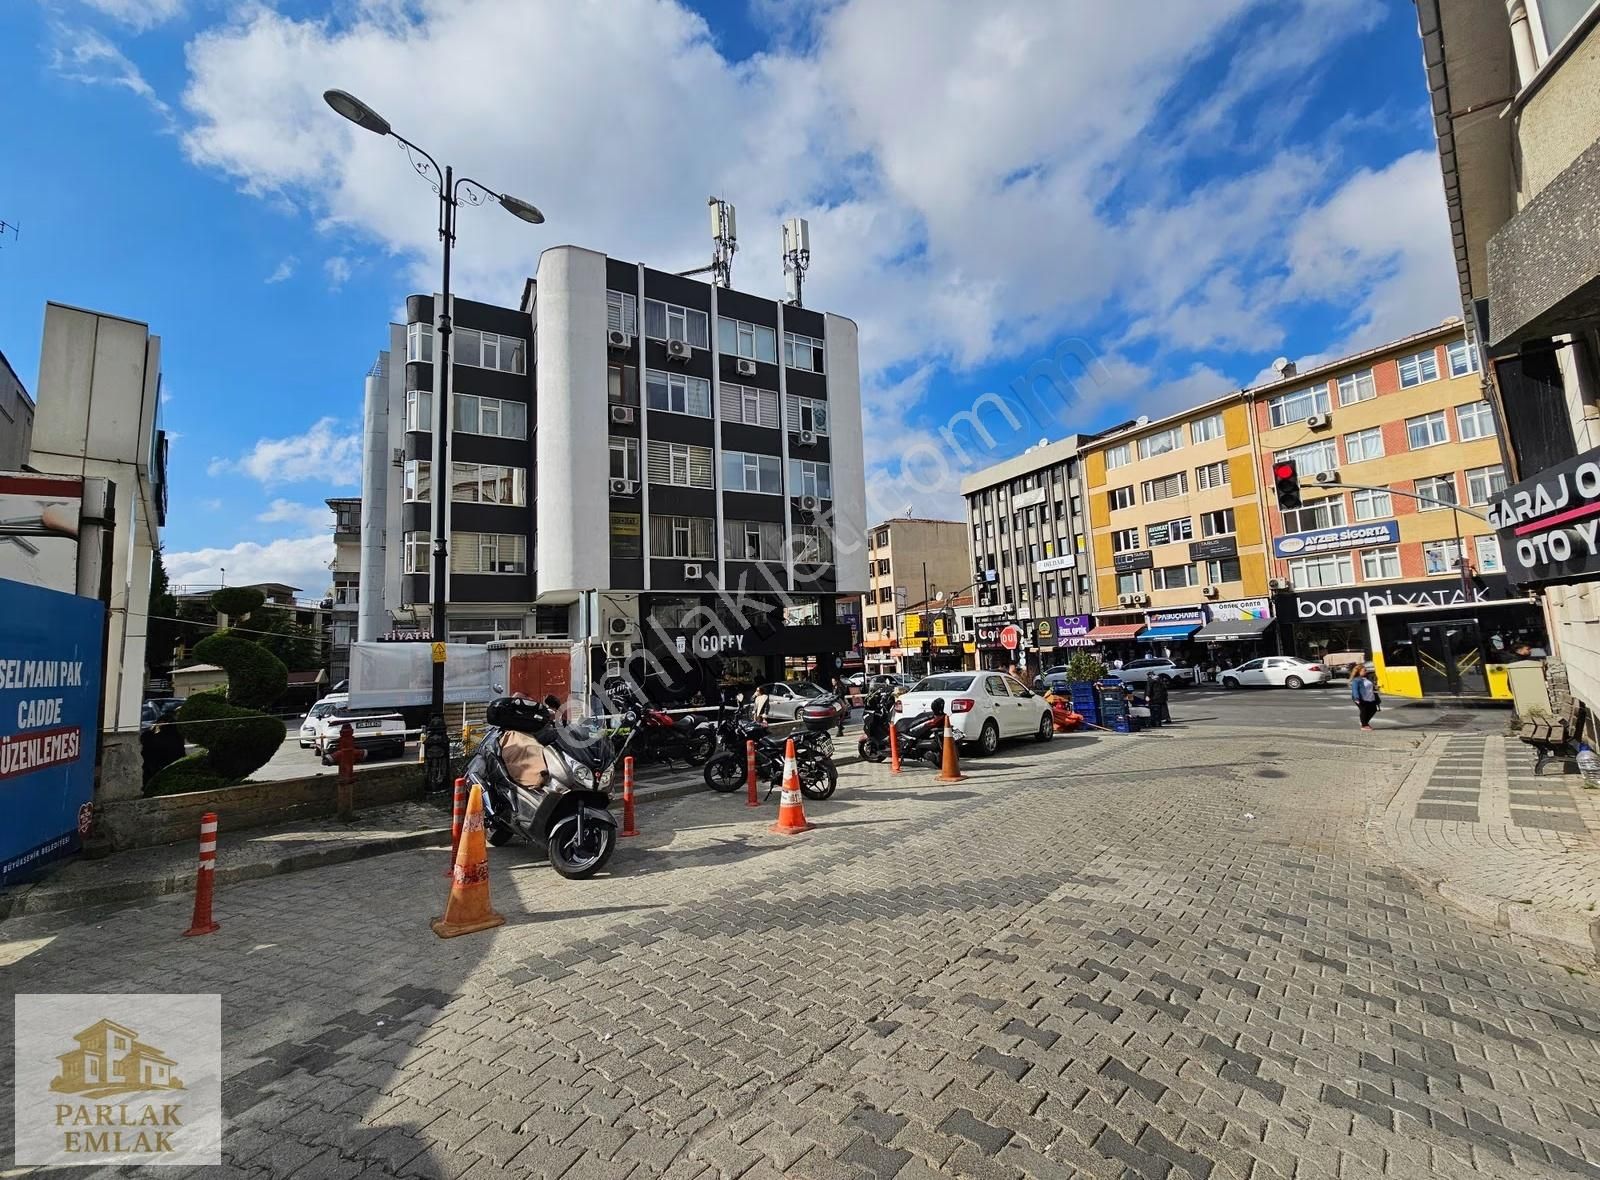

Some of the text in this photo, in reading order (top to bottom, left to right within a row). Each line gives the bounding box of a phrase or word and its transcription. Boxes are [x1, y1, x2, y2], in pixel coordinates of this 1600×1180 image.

[1488, 473, 1569, 530] GARAJ
[1304, 533, 1339, 546] AYZER
[1340, 526, 1390, 540] SİGORTA
[1516, 529, 1571, 568] OTO
[1296, 587, 1490, 618] bambi YATAK
[700, 635, 744, 652] COFFY
[60, 661, 83, 687] PAK
[17, 698, 63, 729] CADDE
